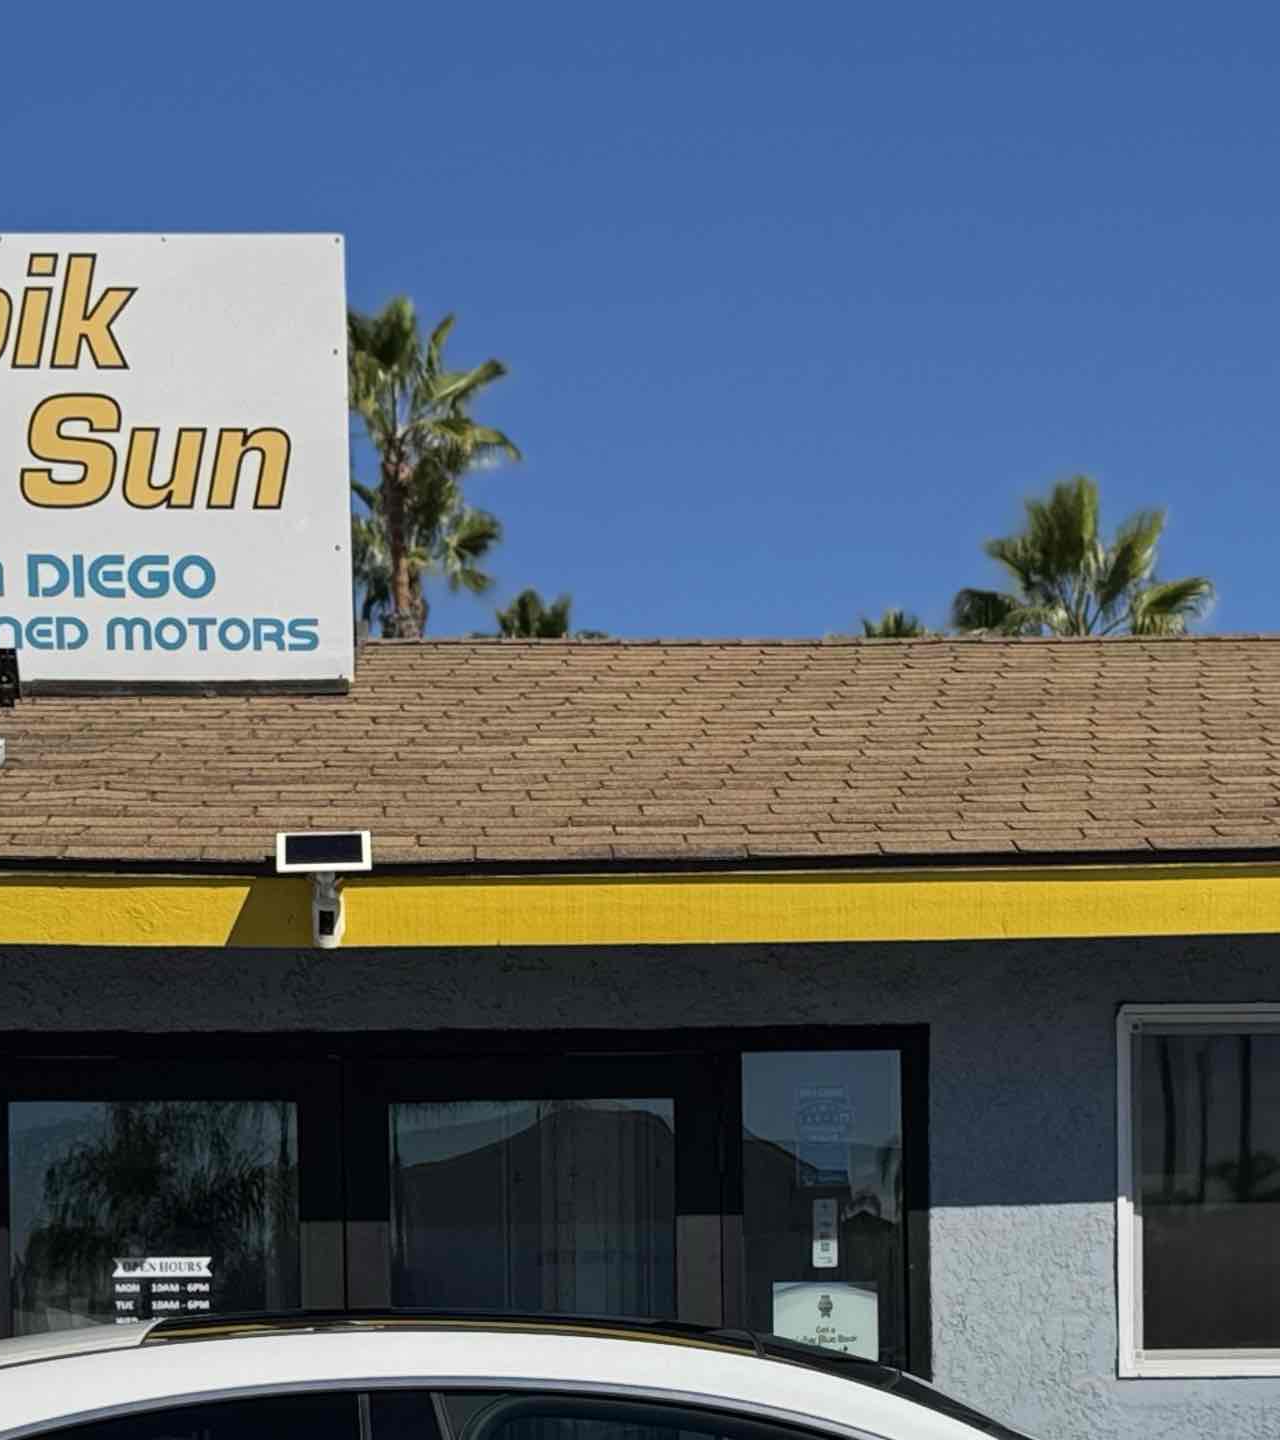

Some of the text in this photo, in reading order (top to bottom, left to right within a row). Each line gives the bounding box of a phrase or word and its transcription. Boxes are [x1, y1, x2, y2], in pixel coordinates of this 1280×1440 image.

[20, 393, 292, 510] Sun
[26, 554, 217, 600] DIEGO
[106, 617, 320, 653] MOTORS
[159, 1262, 203, 1273] HOURS
[115, 1282, 140, 1293] MON
[115, 1300, 134, 1310] TUE
